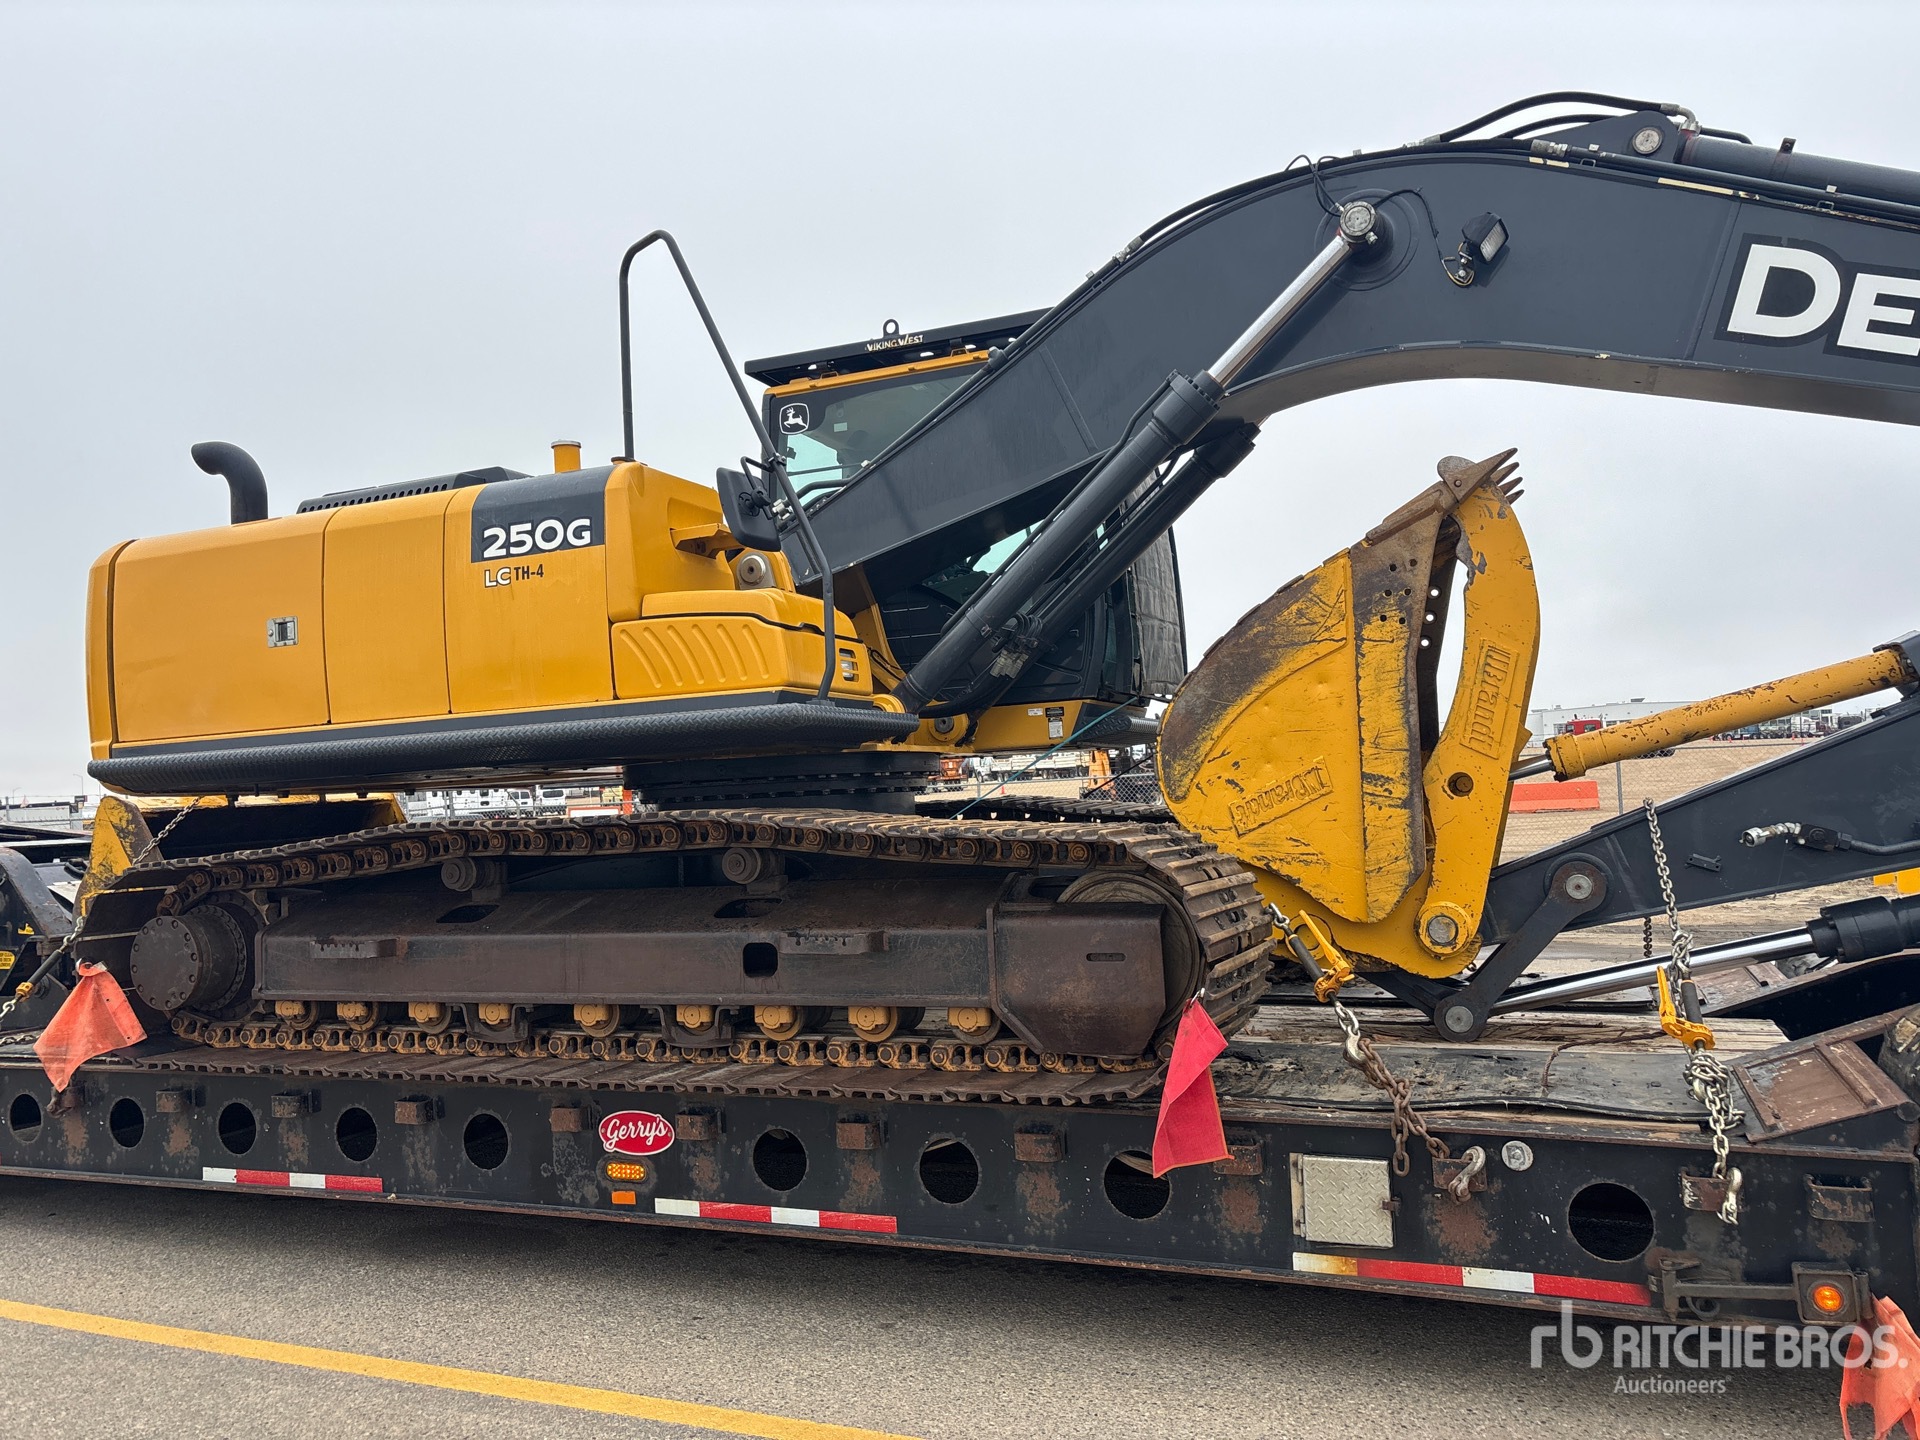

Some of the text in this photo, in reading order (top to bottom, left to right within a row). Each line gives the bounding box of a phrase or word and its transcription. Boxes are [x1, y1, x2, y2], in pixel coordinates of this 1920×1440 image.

[1727, 243, 1920, 356] DE
[866, 334, 924, 351] VIKING WEST
[483, 518, 591, 558] 250G
[484, 563, 544, 588] LC TH-4
[1468, 660, 1509, 751] Brandt
[1235, 773, 1312, 829] Brandt
[605, 1117, 669, 1149] Gerry's
